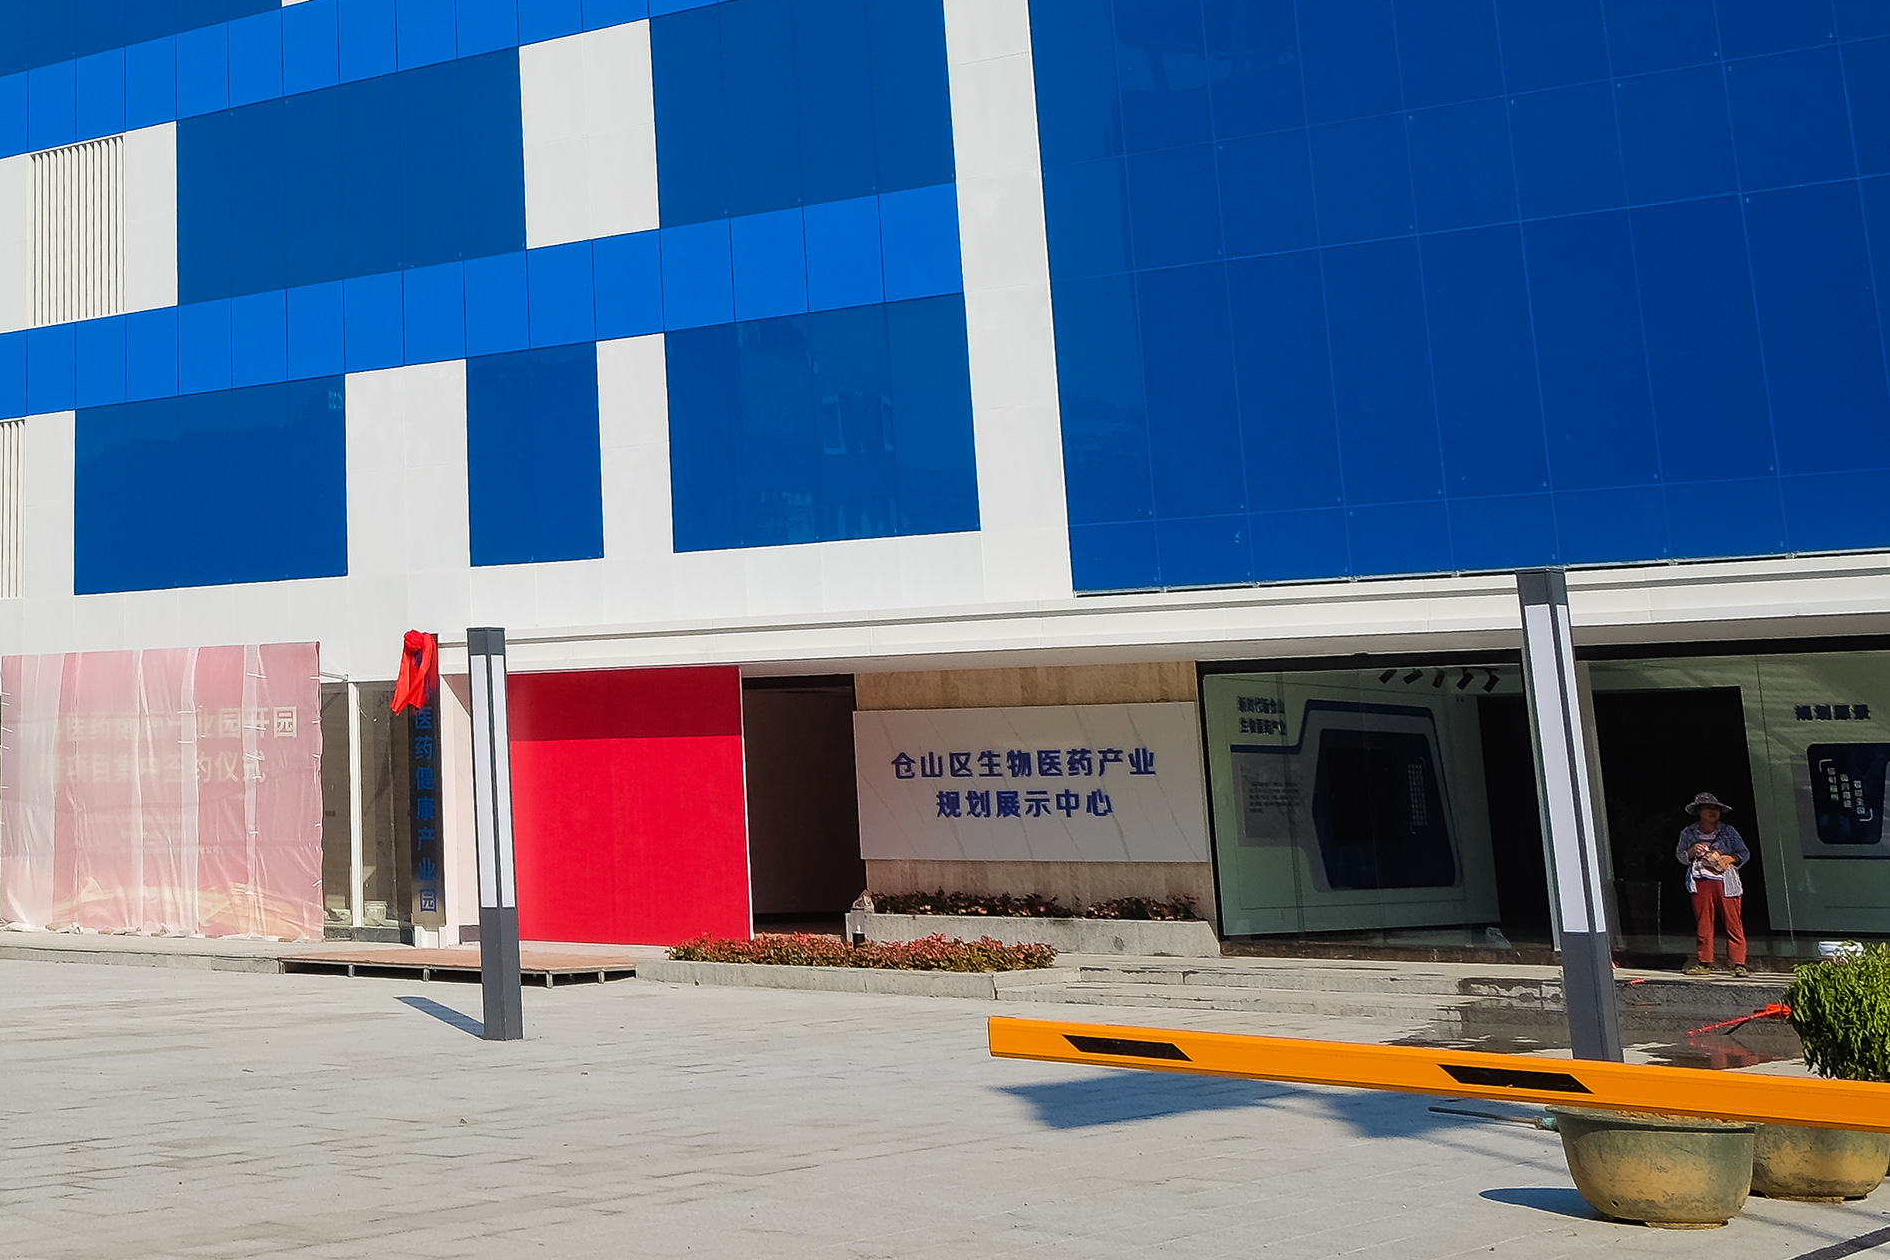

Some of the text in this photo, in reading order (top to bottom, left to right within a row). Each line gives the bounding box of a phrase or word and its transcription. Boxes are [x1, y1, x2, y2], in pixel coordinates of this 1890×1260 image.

[413, 648, 439, 913] 医药健康产业园
[890, 747, 1157, 781] 仓山区生物医药产业
[935, 788, 1115, 819] 规划展示中心
